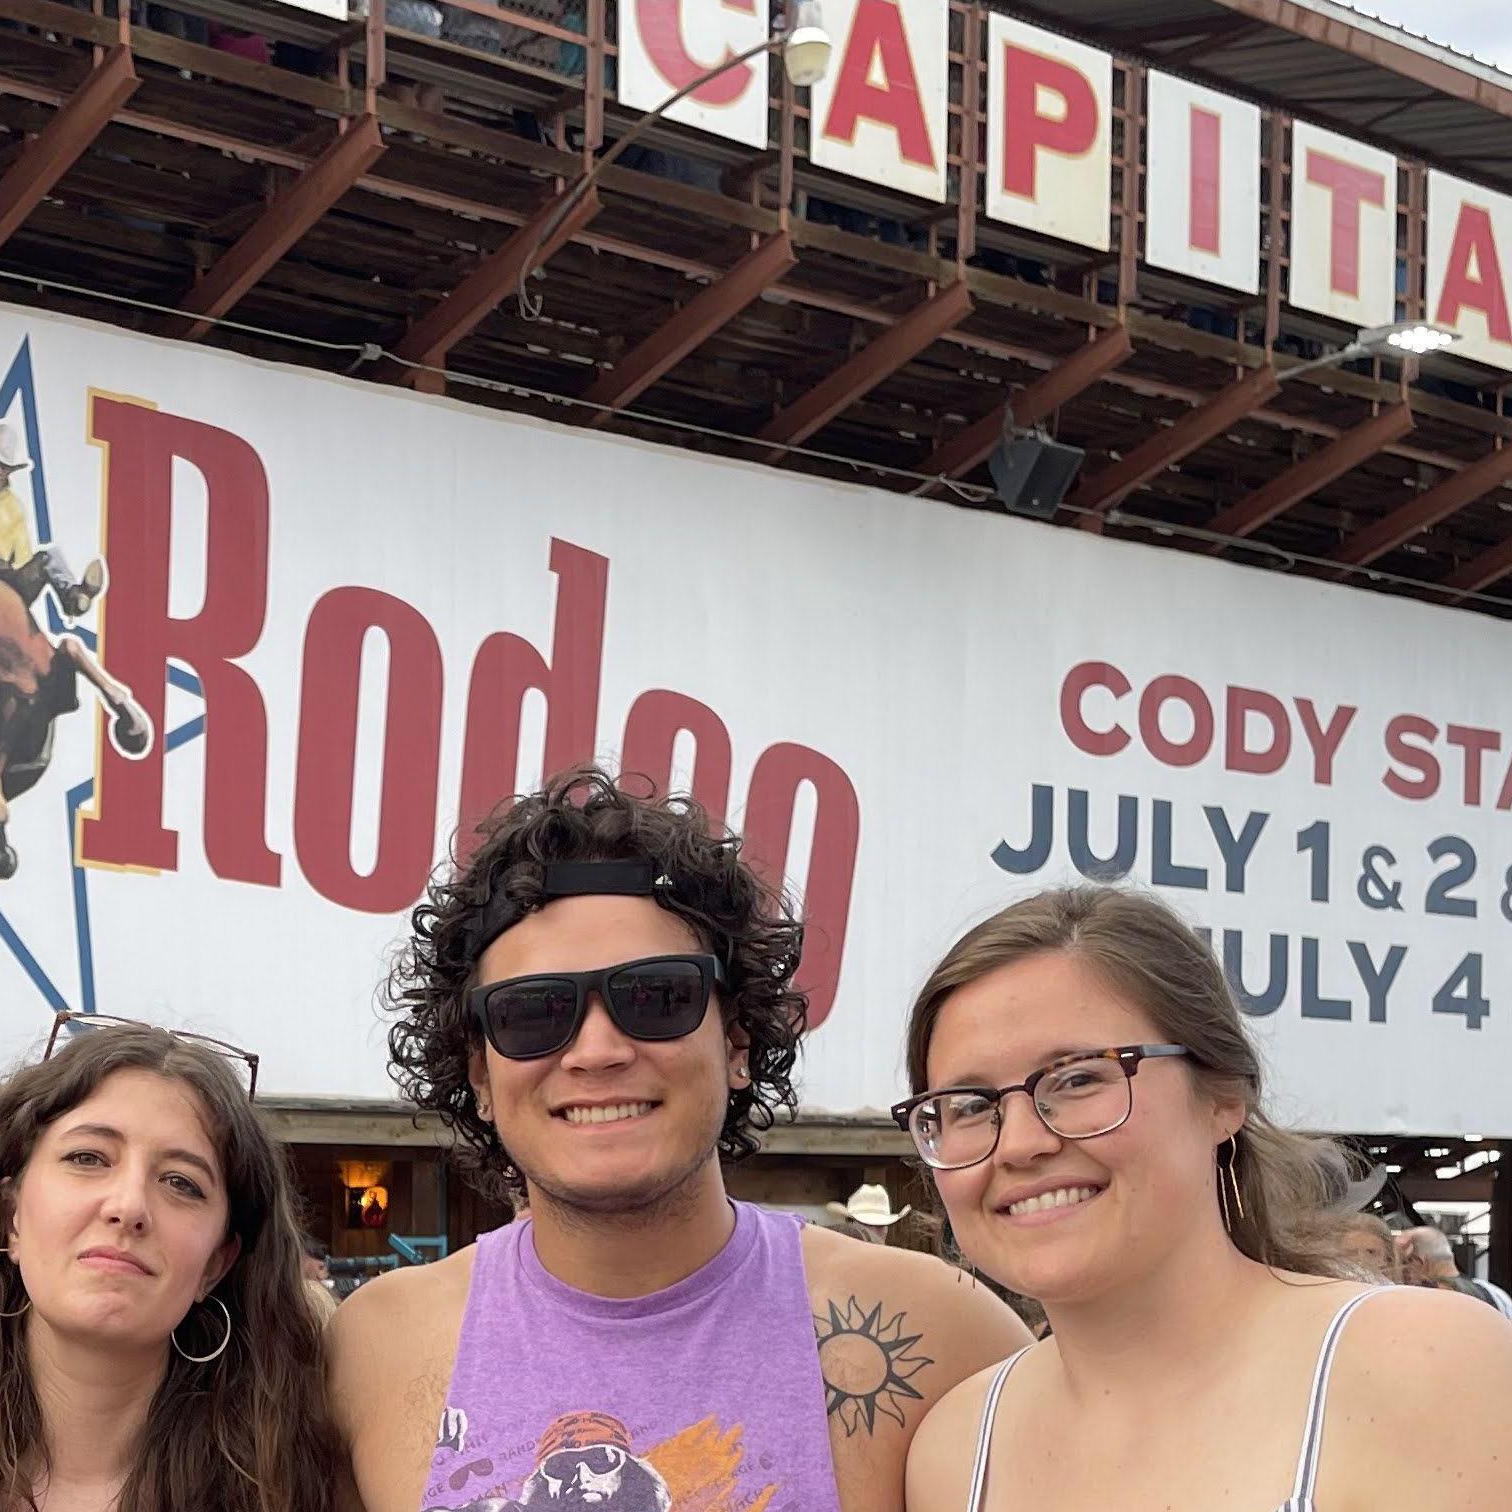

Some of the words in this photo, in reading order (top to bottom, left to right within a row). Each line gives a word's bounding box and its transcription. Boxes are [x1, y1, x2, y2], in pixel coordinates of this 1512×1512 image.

[1059, 660, 1357, 786] CODY
[1381, 713, 1512, 812] ST
[989, 783, 1271, 893] JULY
[1295, 820, 1331, 903] 1
[1356, 845, 1403, 911] &
[1424, 835, 1479, 919] 2
[1193, 928, 1408, 1024] ULY
[1431, 951, 1490, 1030] 4
